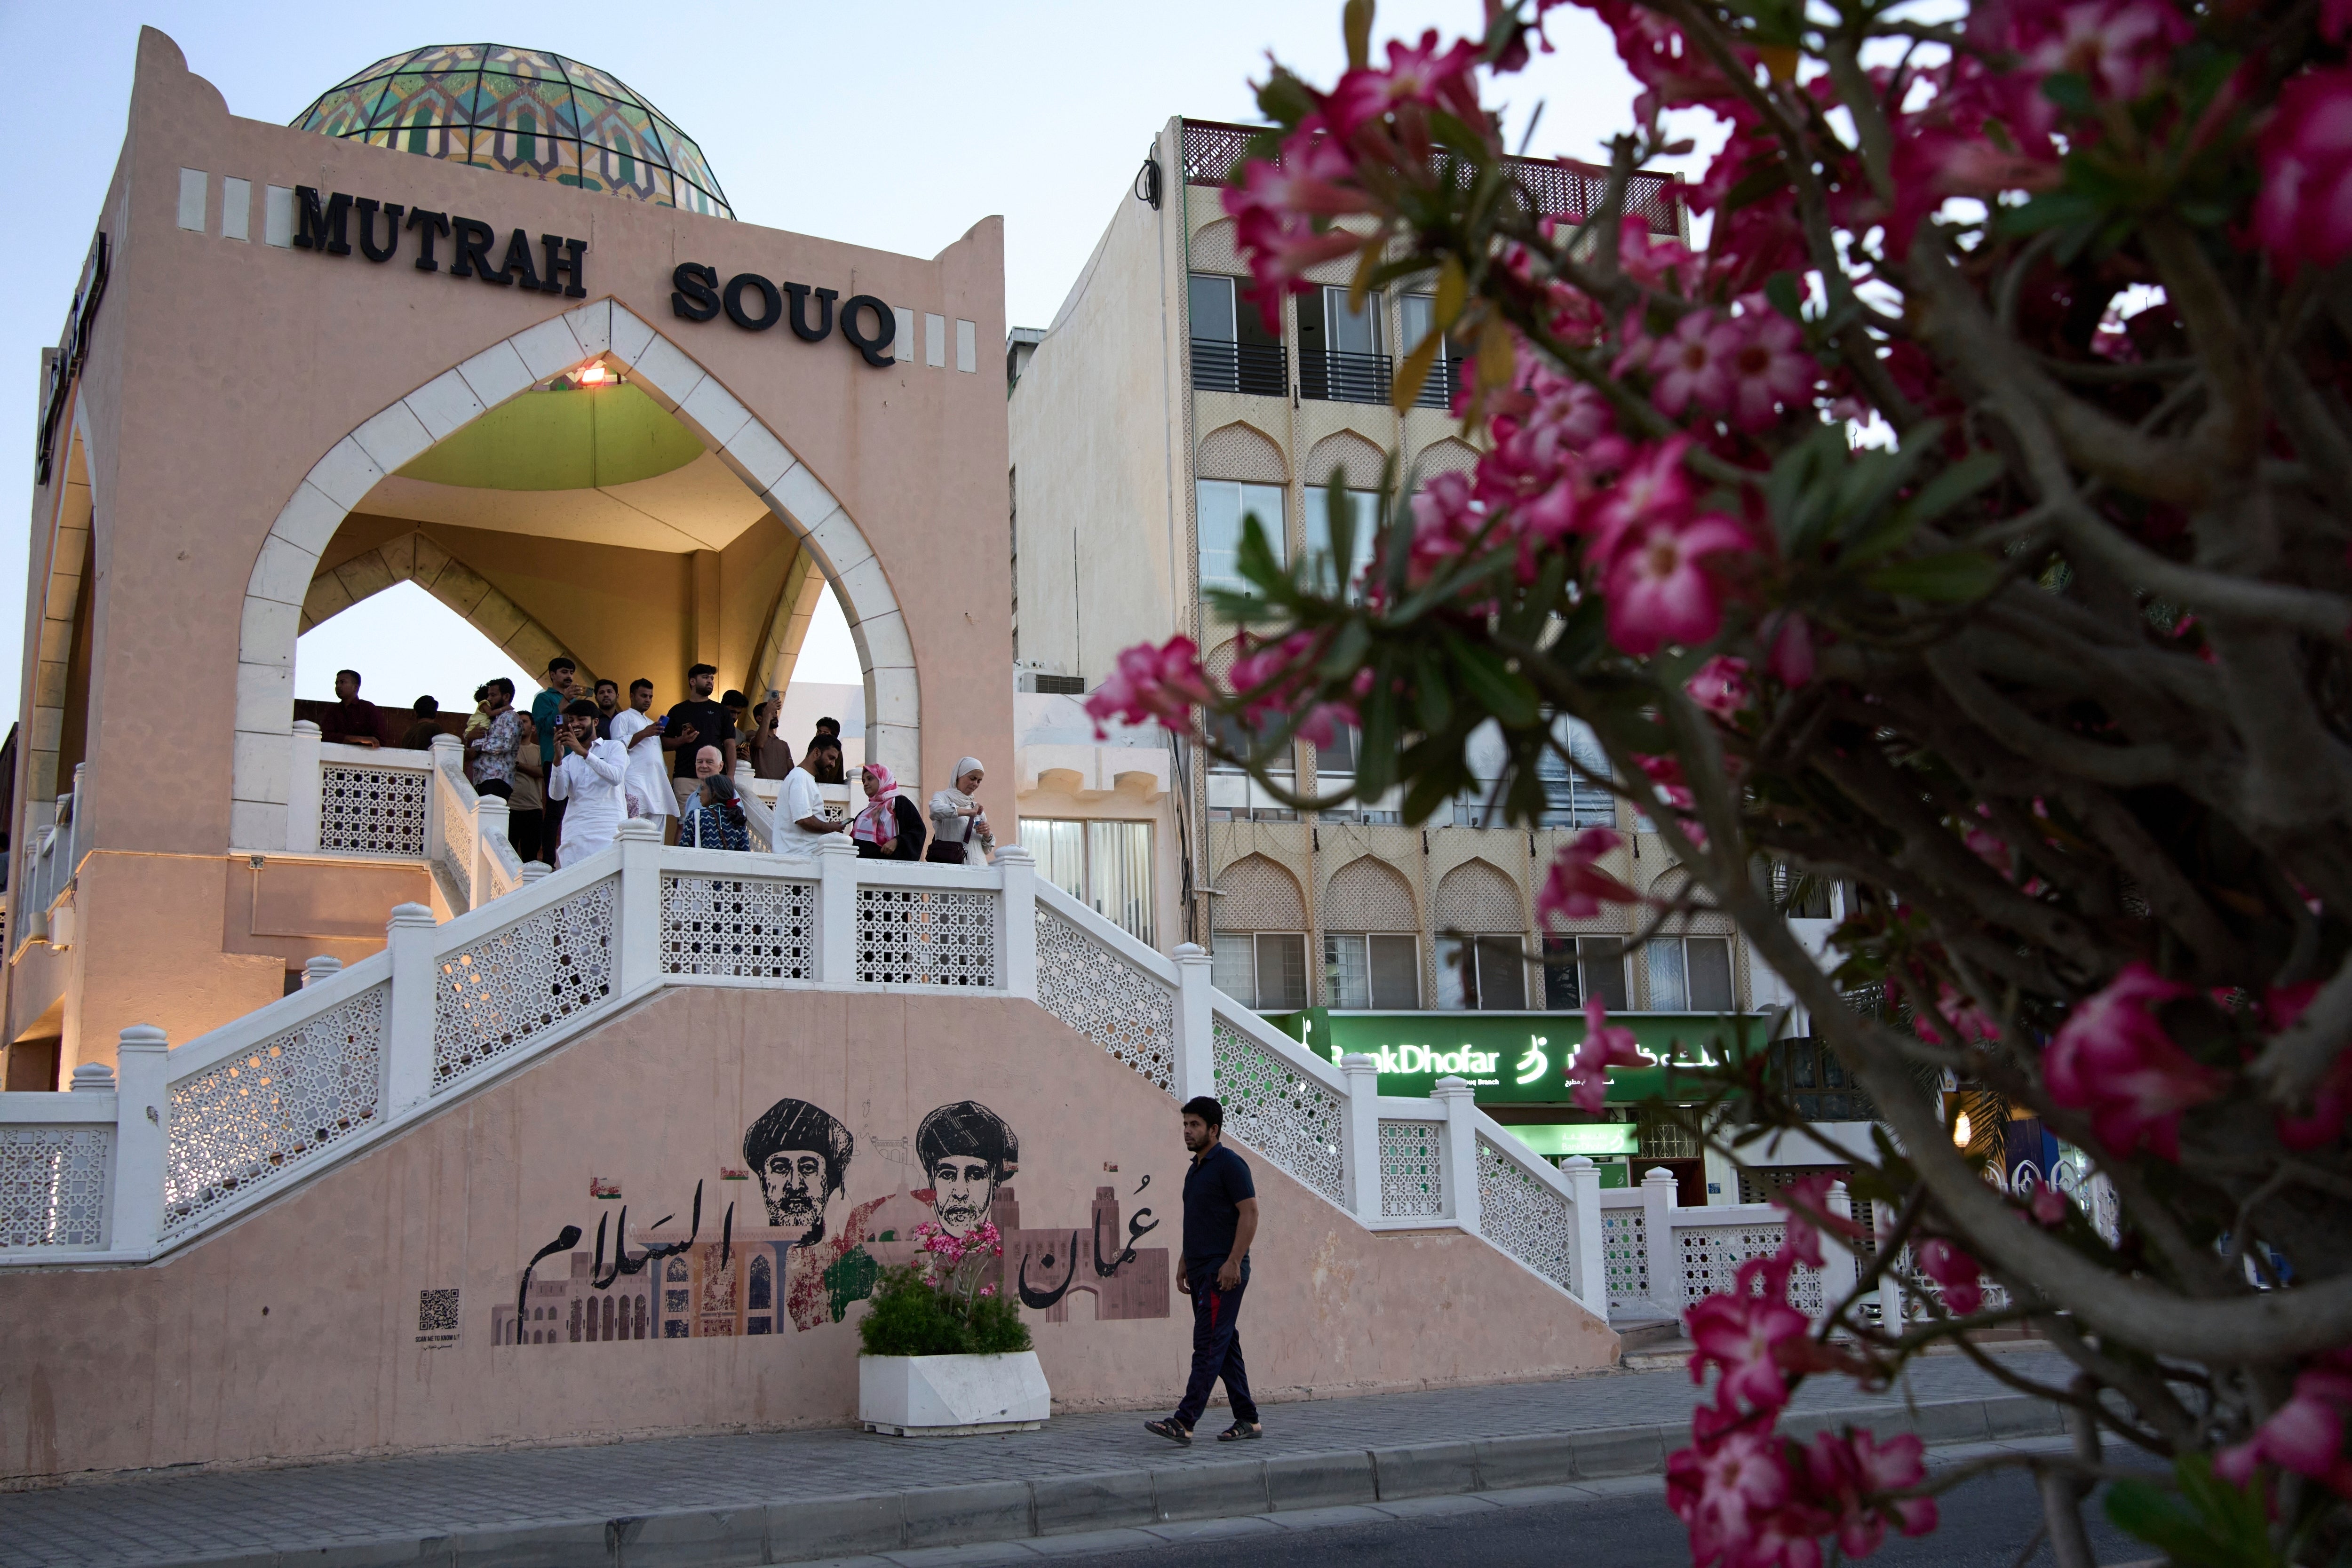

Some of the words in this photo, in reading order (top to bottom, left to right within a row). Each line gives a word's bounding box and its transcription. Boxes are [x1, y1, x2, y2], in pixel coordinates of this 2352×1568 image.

[293, 185, 588, 298] MUTRAH
[671, 262, 896, 368] SOUQ
[1331, 1044, 1500, 1074] BnkDhofar
